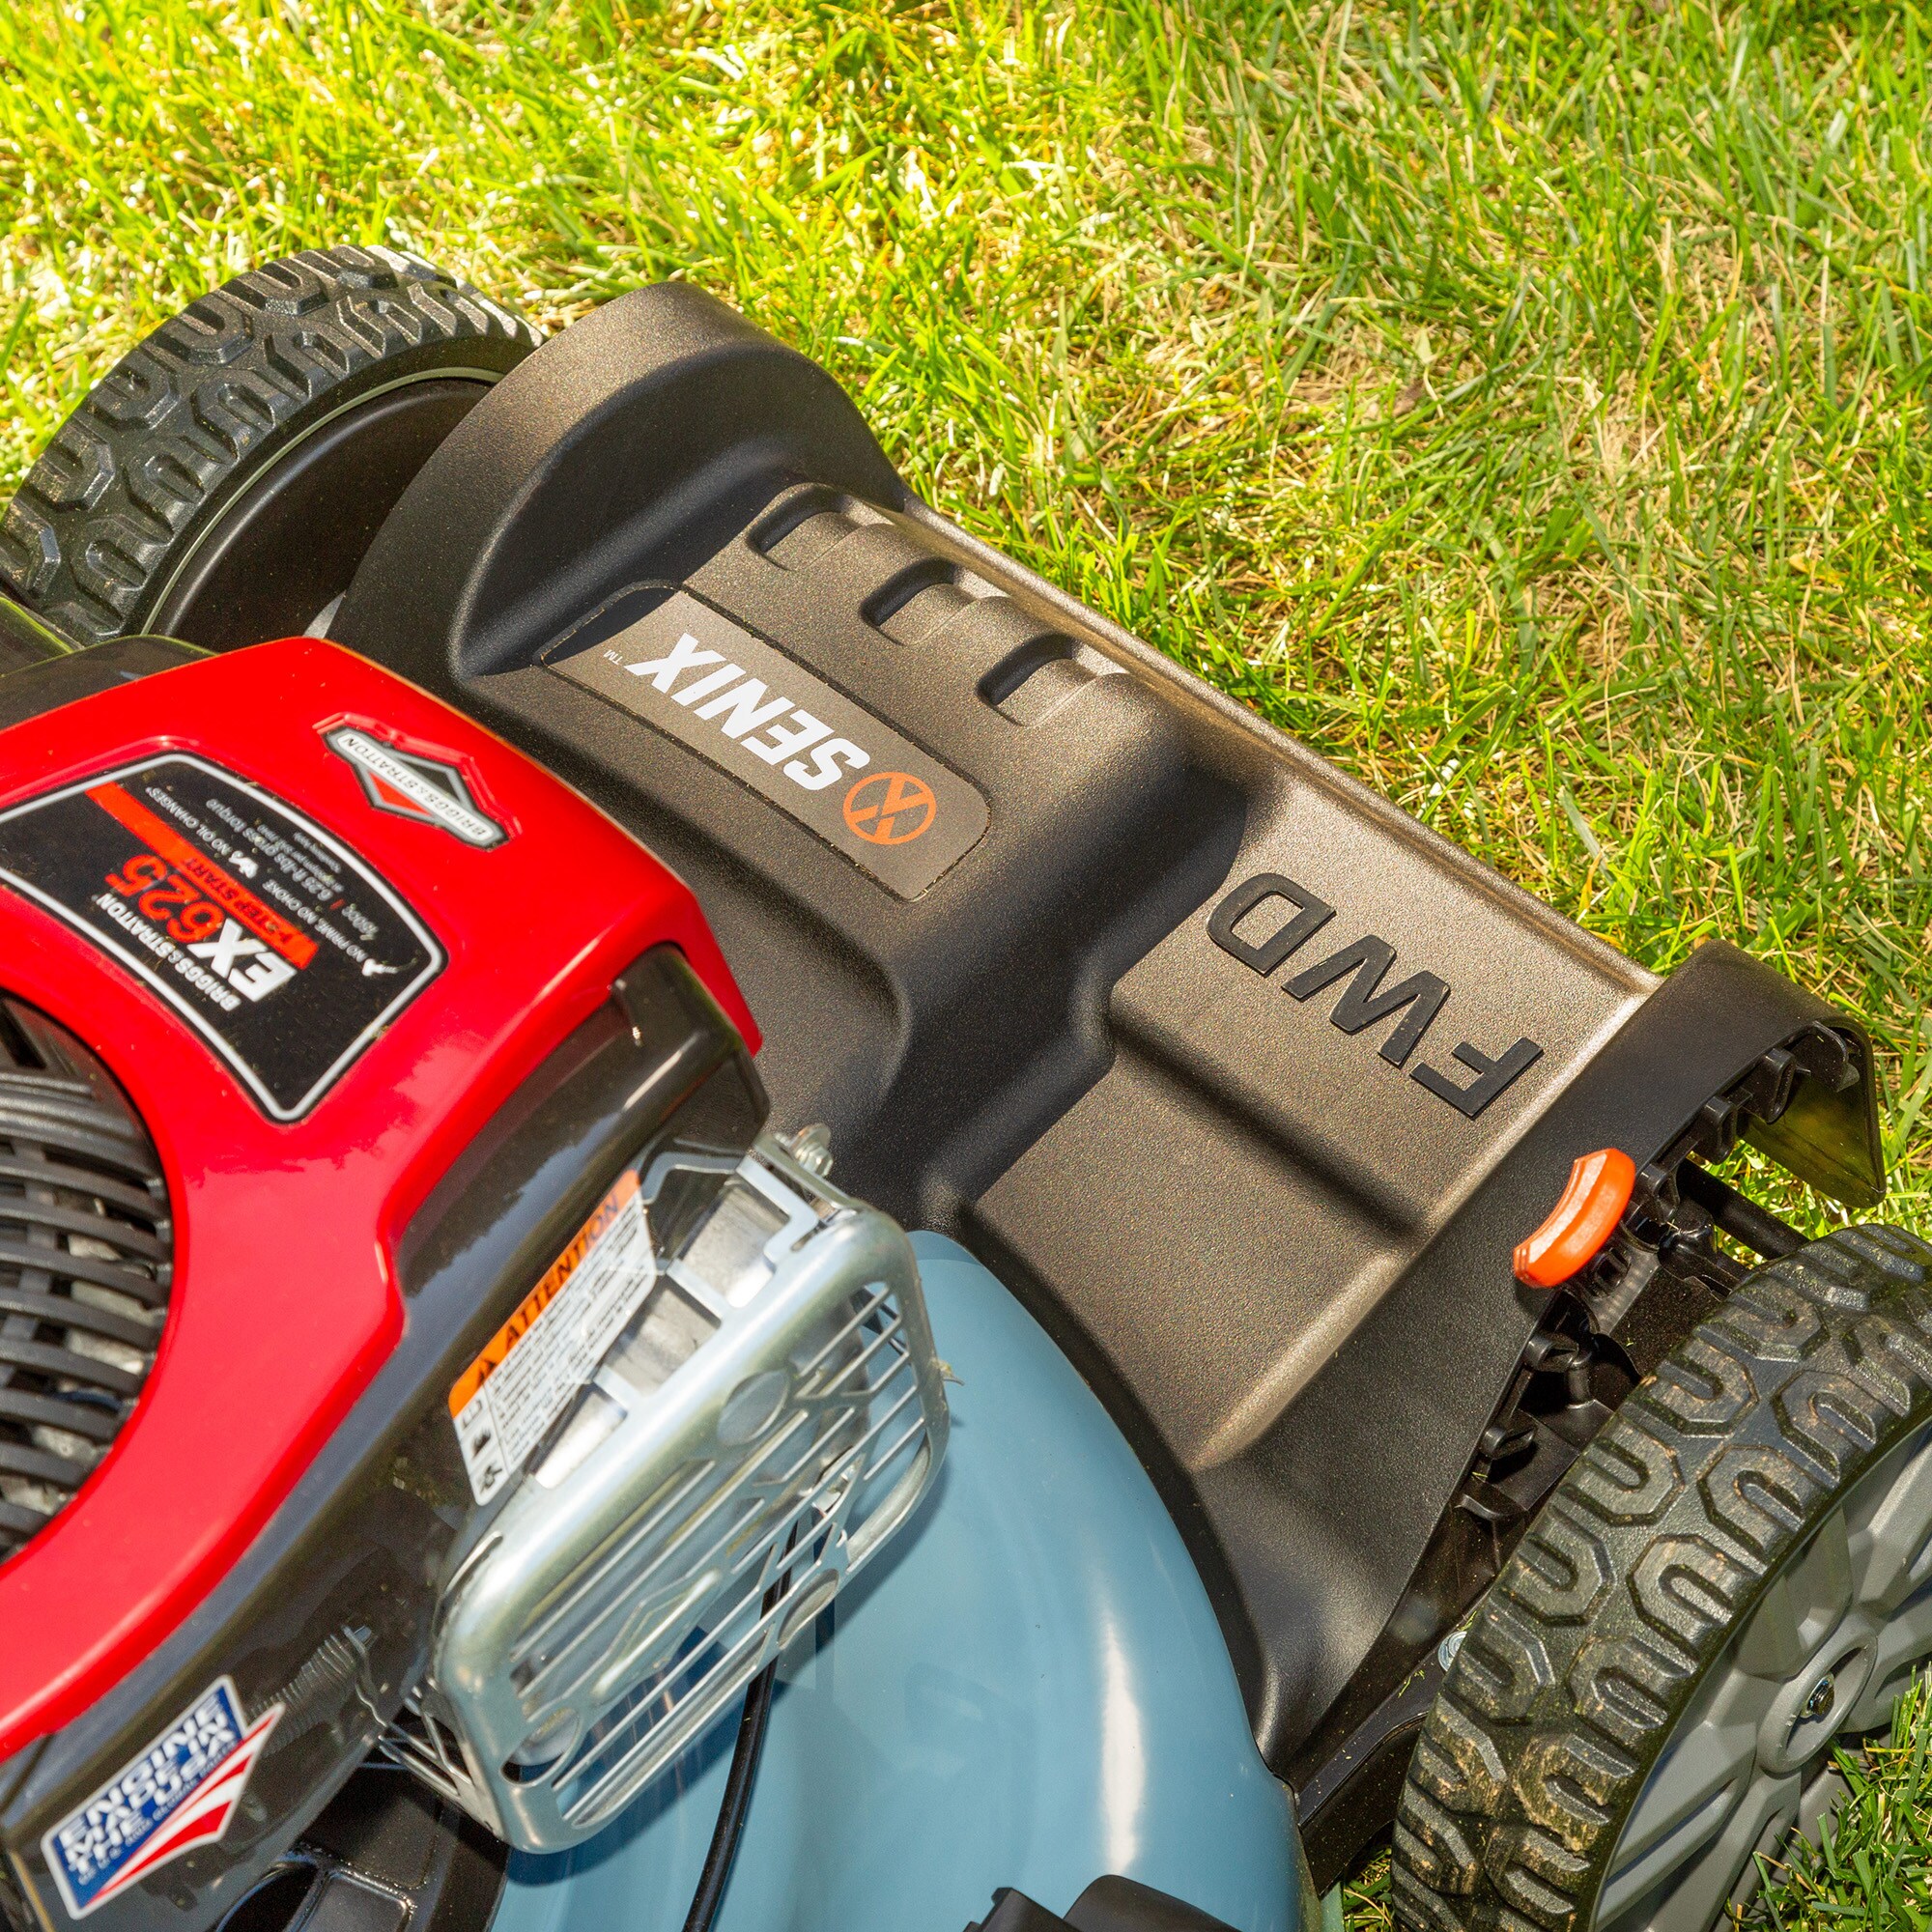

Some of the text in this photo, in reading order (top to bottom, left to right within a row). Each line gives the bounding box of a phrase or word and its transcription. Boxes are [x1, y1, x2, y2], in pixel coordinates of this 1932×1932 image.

[624, 633, 870, 791] SENIX
[196, 823, 216, 842] OIL
[205, 798, 247, 834] torque
[211, 838, 233, 856] NO
[185, 857, 240, 901] START
[262, 878, 303, 911] CHOKE
[300, 876, 334, 901] 6.25
[104, 853, 298, 1003] EX625
[297, 906, 319, 924] NO
[345, 943, 369, 963] NO
[1207, 871, 1545, 1120] FWD
[505, 1192, 619, 1351] ATTENTION
[59, 1692, 220, 1849] ENGINE
[64, 1712, 228, 1865] MADE IN
[68, 1807, 144, 1873] THE
